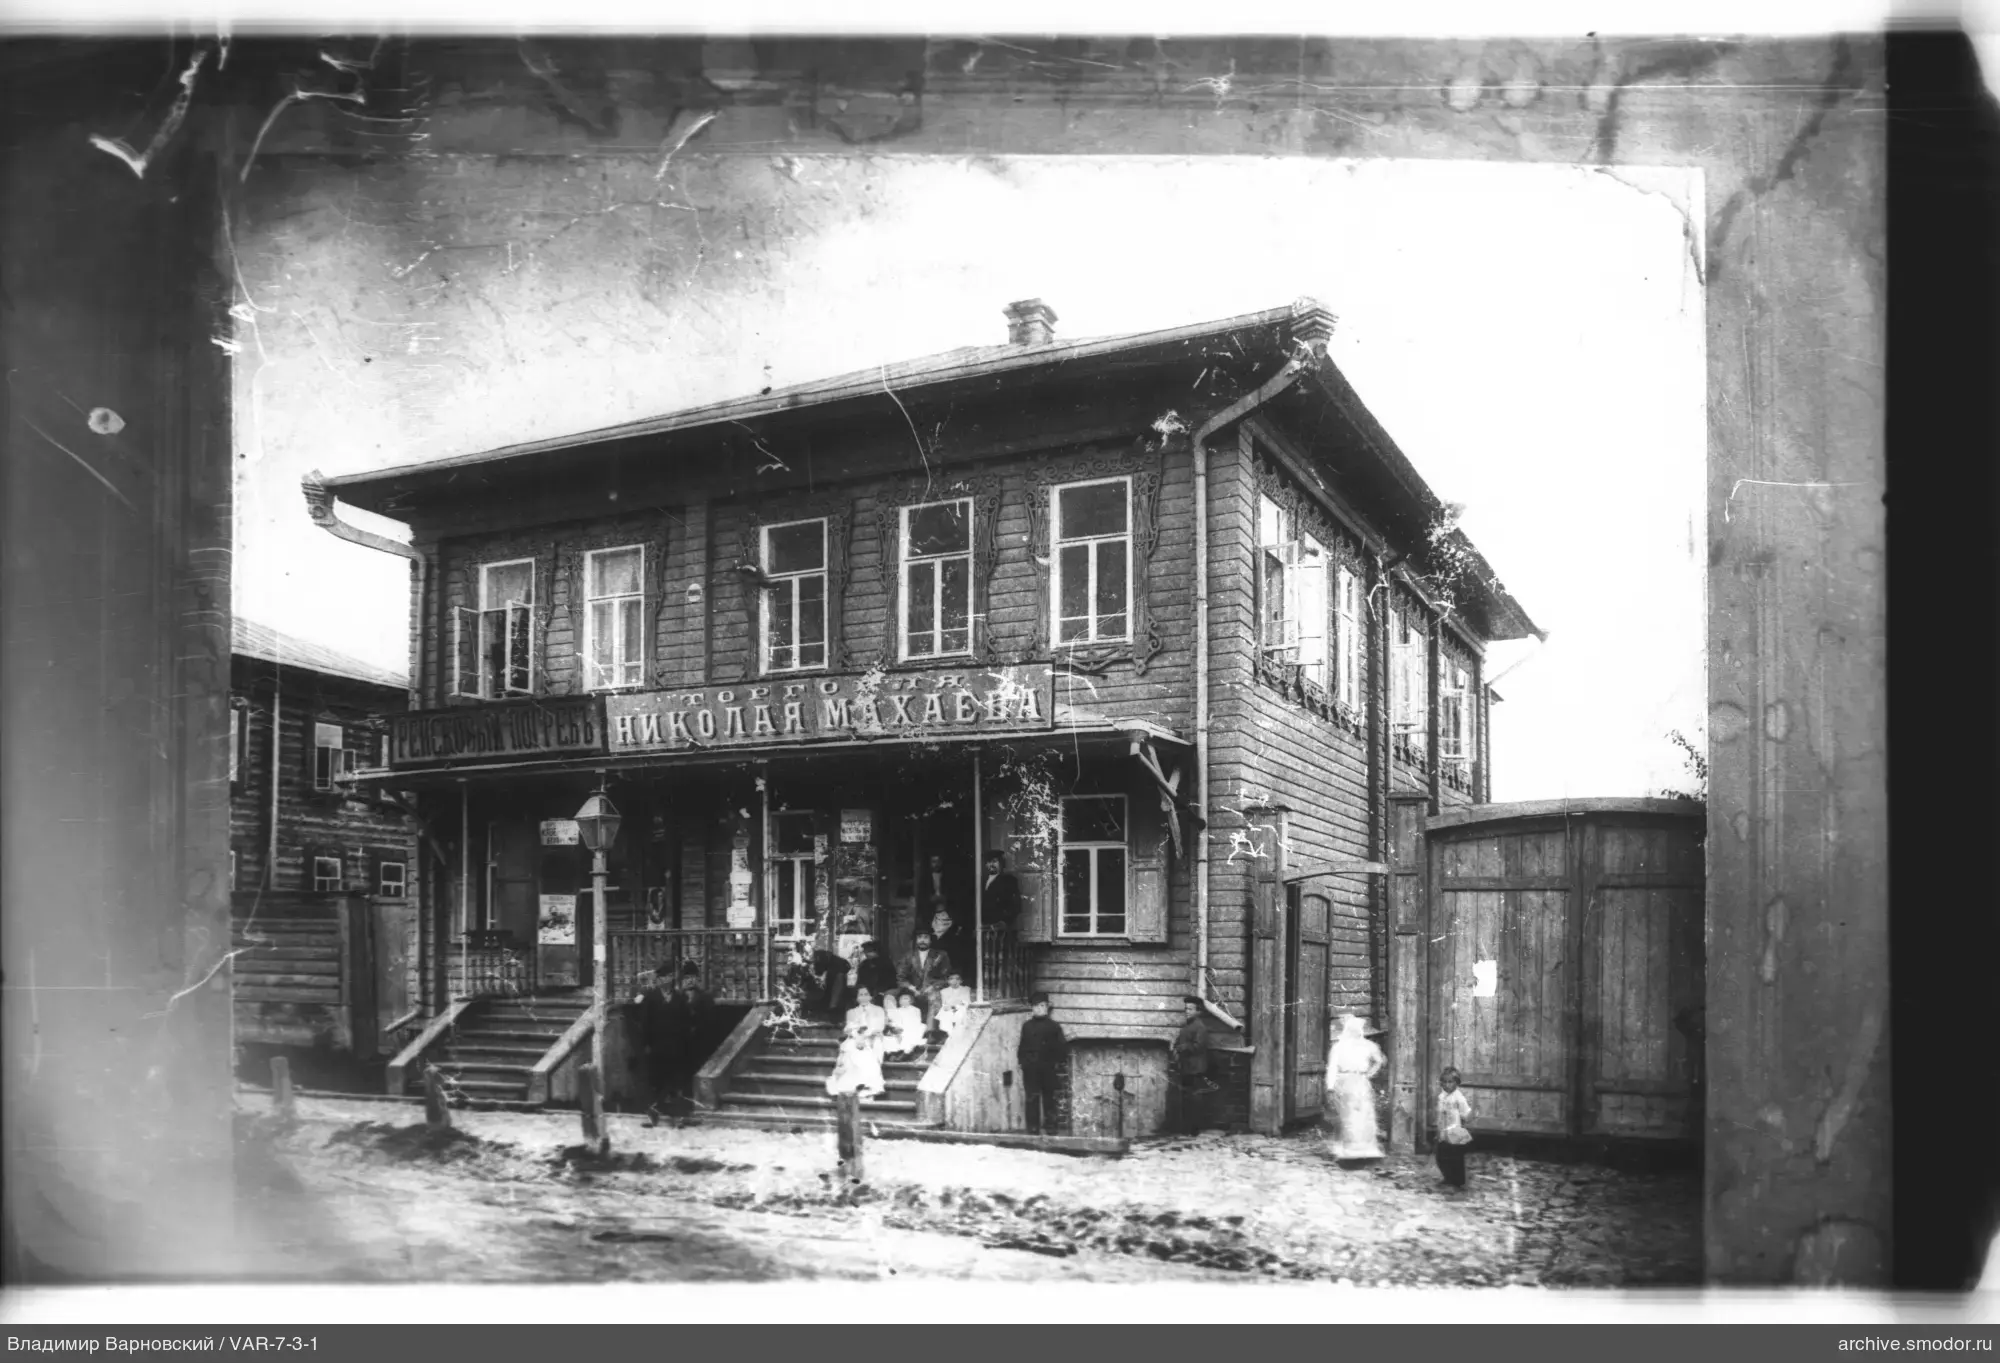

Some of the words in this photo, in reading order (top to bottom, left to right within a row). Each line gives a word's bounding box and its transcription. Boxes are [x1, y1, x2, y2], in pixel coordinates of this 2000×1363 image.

[679, 675, 962, 706] ТОРГОЛЯ
[614, 701, 807, 746] НИКОЛАЯ
[819, 688, 1043, 731] МАХАЕВА
